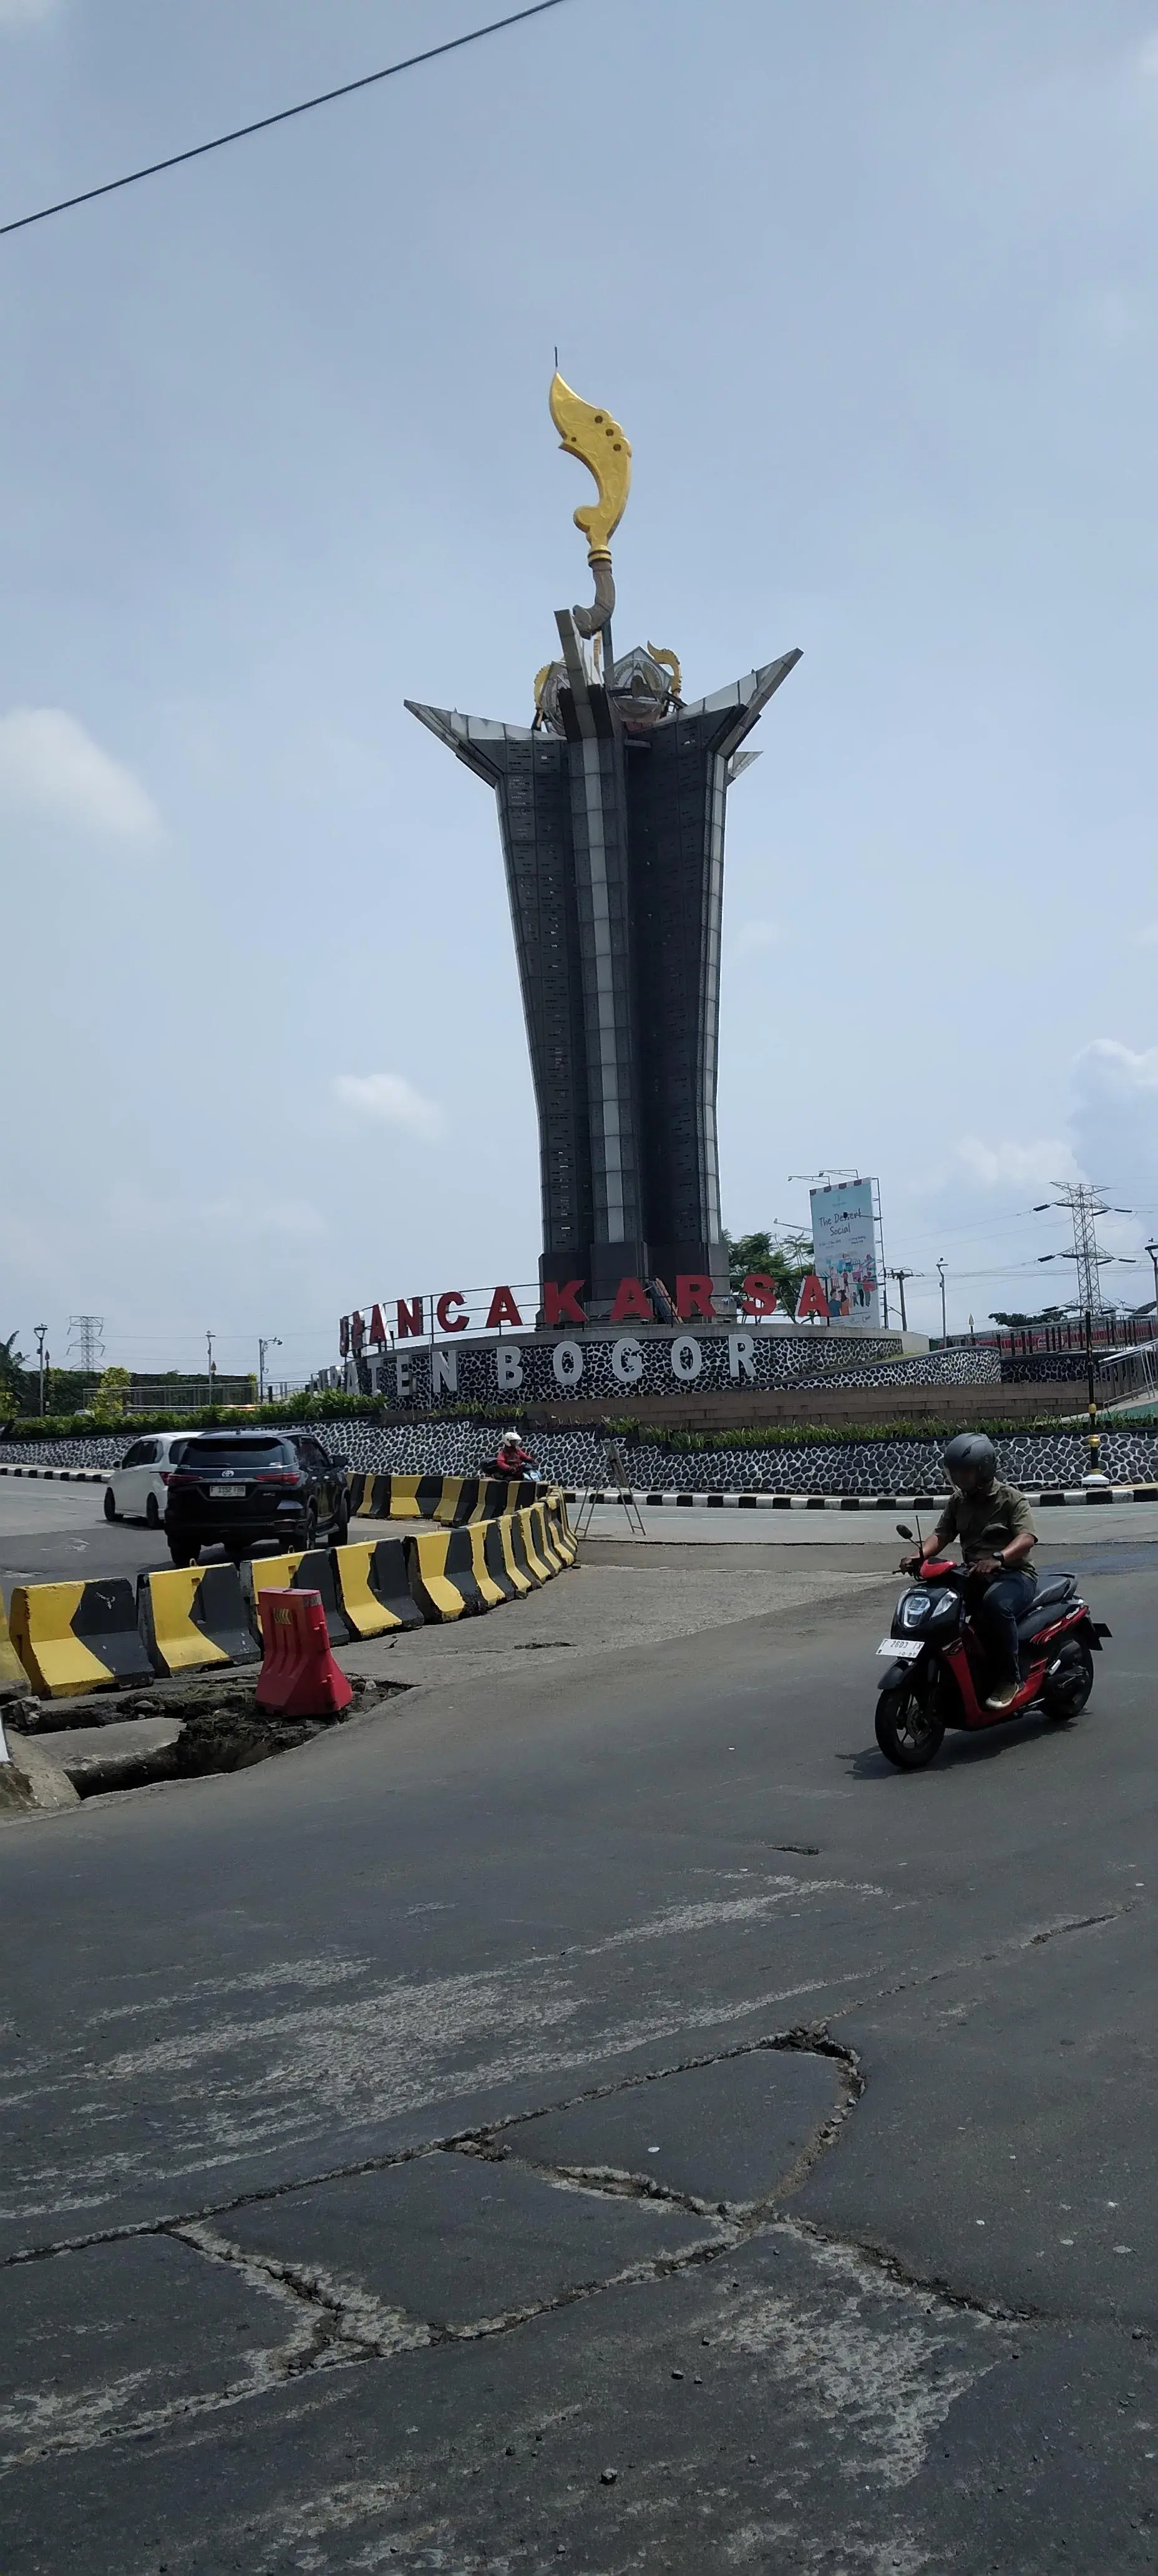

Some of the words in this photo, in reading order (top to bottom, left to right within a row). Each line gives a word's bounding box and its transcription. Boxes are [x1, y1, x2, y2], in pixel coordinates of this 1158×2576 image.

[819, 1217, 832, 1227] The
[830, 1222, 851, 1236] Social
[496, 1334, 758, 1390] BOGOR
